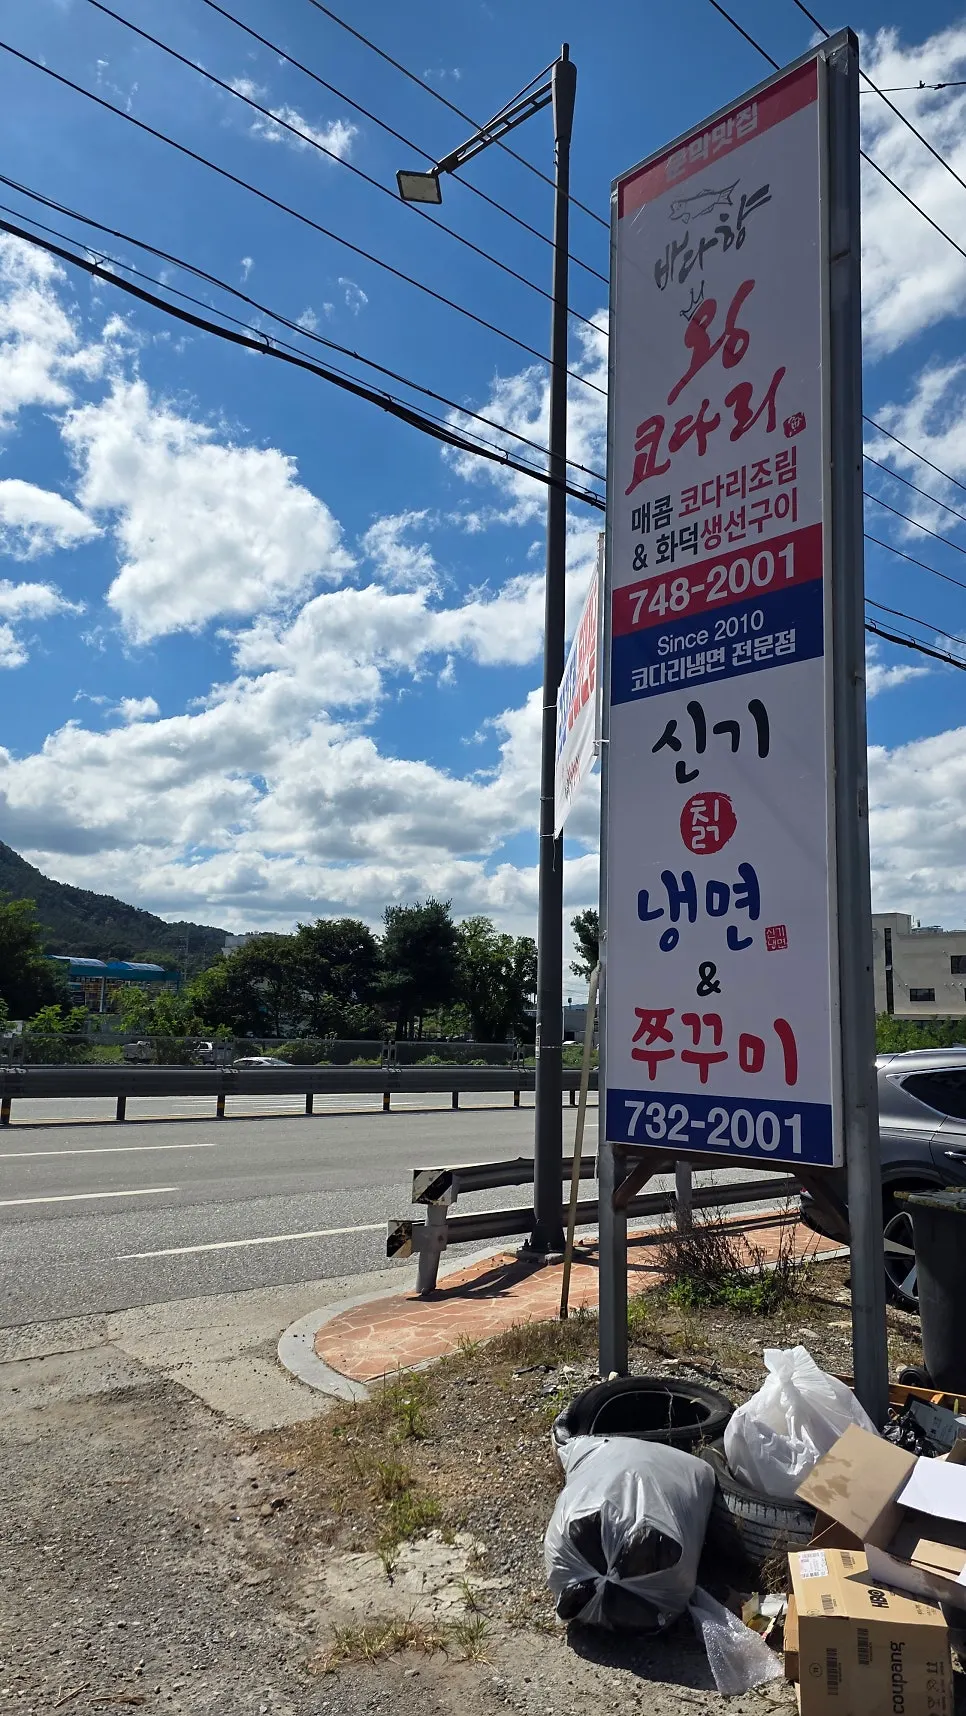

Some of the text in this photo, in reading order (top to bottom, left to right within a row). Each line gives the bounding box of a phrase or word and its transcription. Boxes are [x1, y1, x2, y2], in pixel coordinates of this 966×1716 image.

[654, 184, 772, 291] 바다향
[667, 279, 756, 406] 왕
[624, 366, 786, 496] 코다리
[631, 445, 798, 534] 매콤 코다리조림
[628, 542, 796, 625] 748-2001
[632, 543, 649, 572] &
[631, 628, 796, 692] 코다리냉면 전문점
[657, 609, 764, 656] Since 2010
[652, 698, 770, 784] 신기
[690, 800, 720, 849] 칡
[637, 862, 761, 953] 냉면
[696, 961, 721, 996] &
[631, 1007, 798, 1087] 쭈꾸미
[624, 1100, 802, 1154] 732-2001
[890, 1640, 908, 1714] coupang
